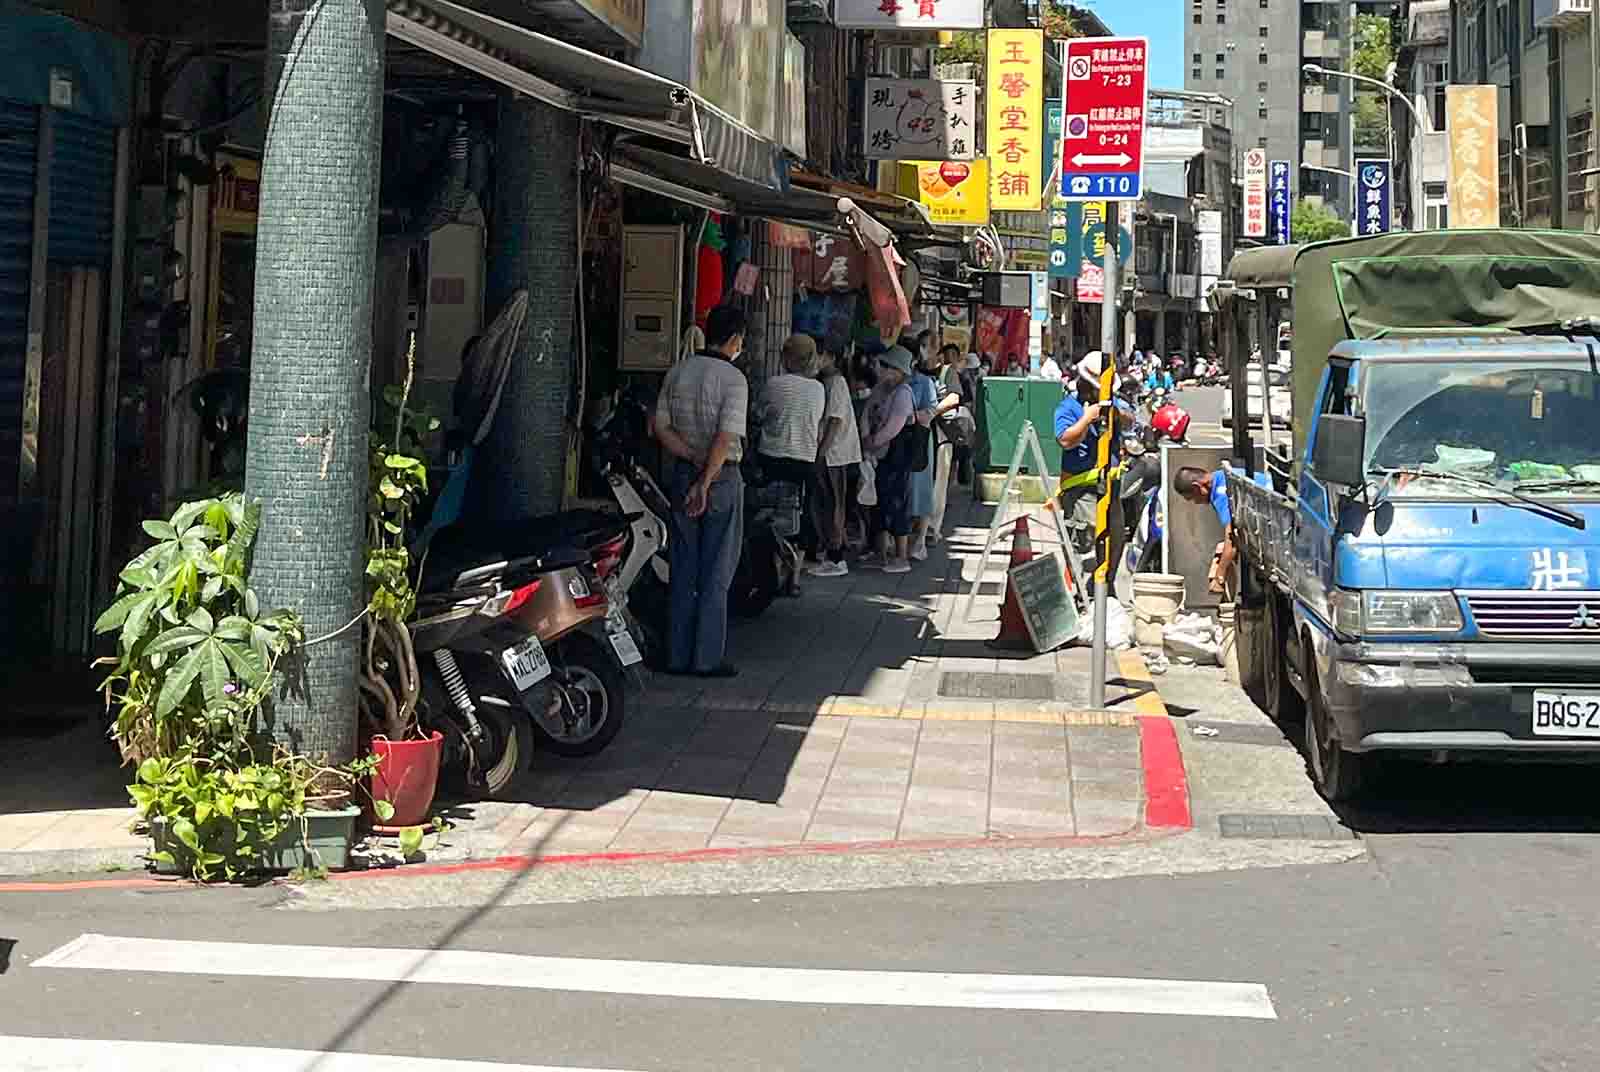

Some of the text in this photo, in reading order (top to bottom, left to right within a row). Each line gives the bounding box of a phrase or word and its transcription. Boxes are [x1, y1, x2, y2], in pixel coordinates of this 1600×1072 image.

[1102, 74, 1131, 87] 7-23
[1099, 133, 1128, 146] 0-24
[1097, 176, 1130, 193] 110
[1532, 548, 1584, 591] 壯
